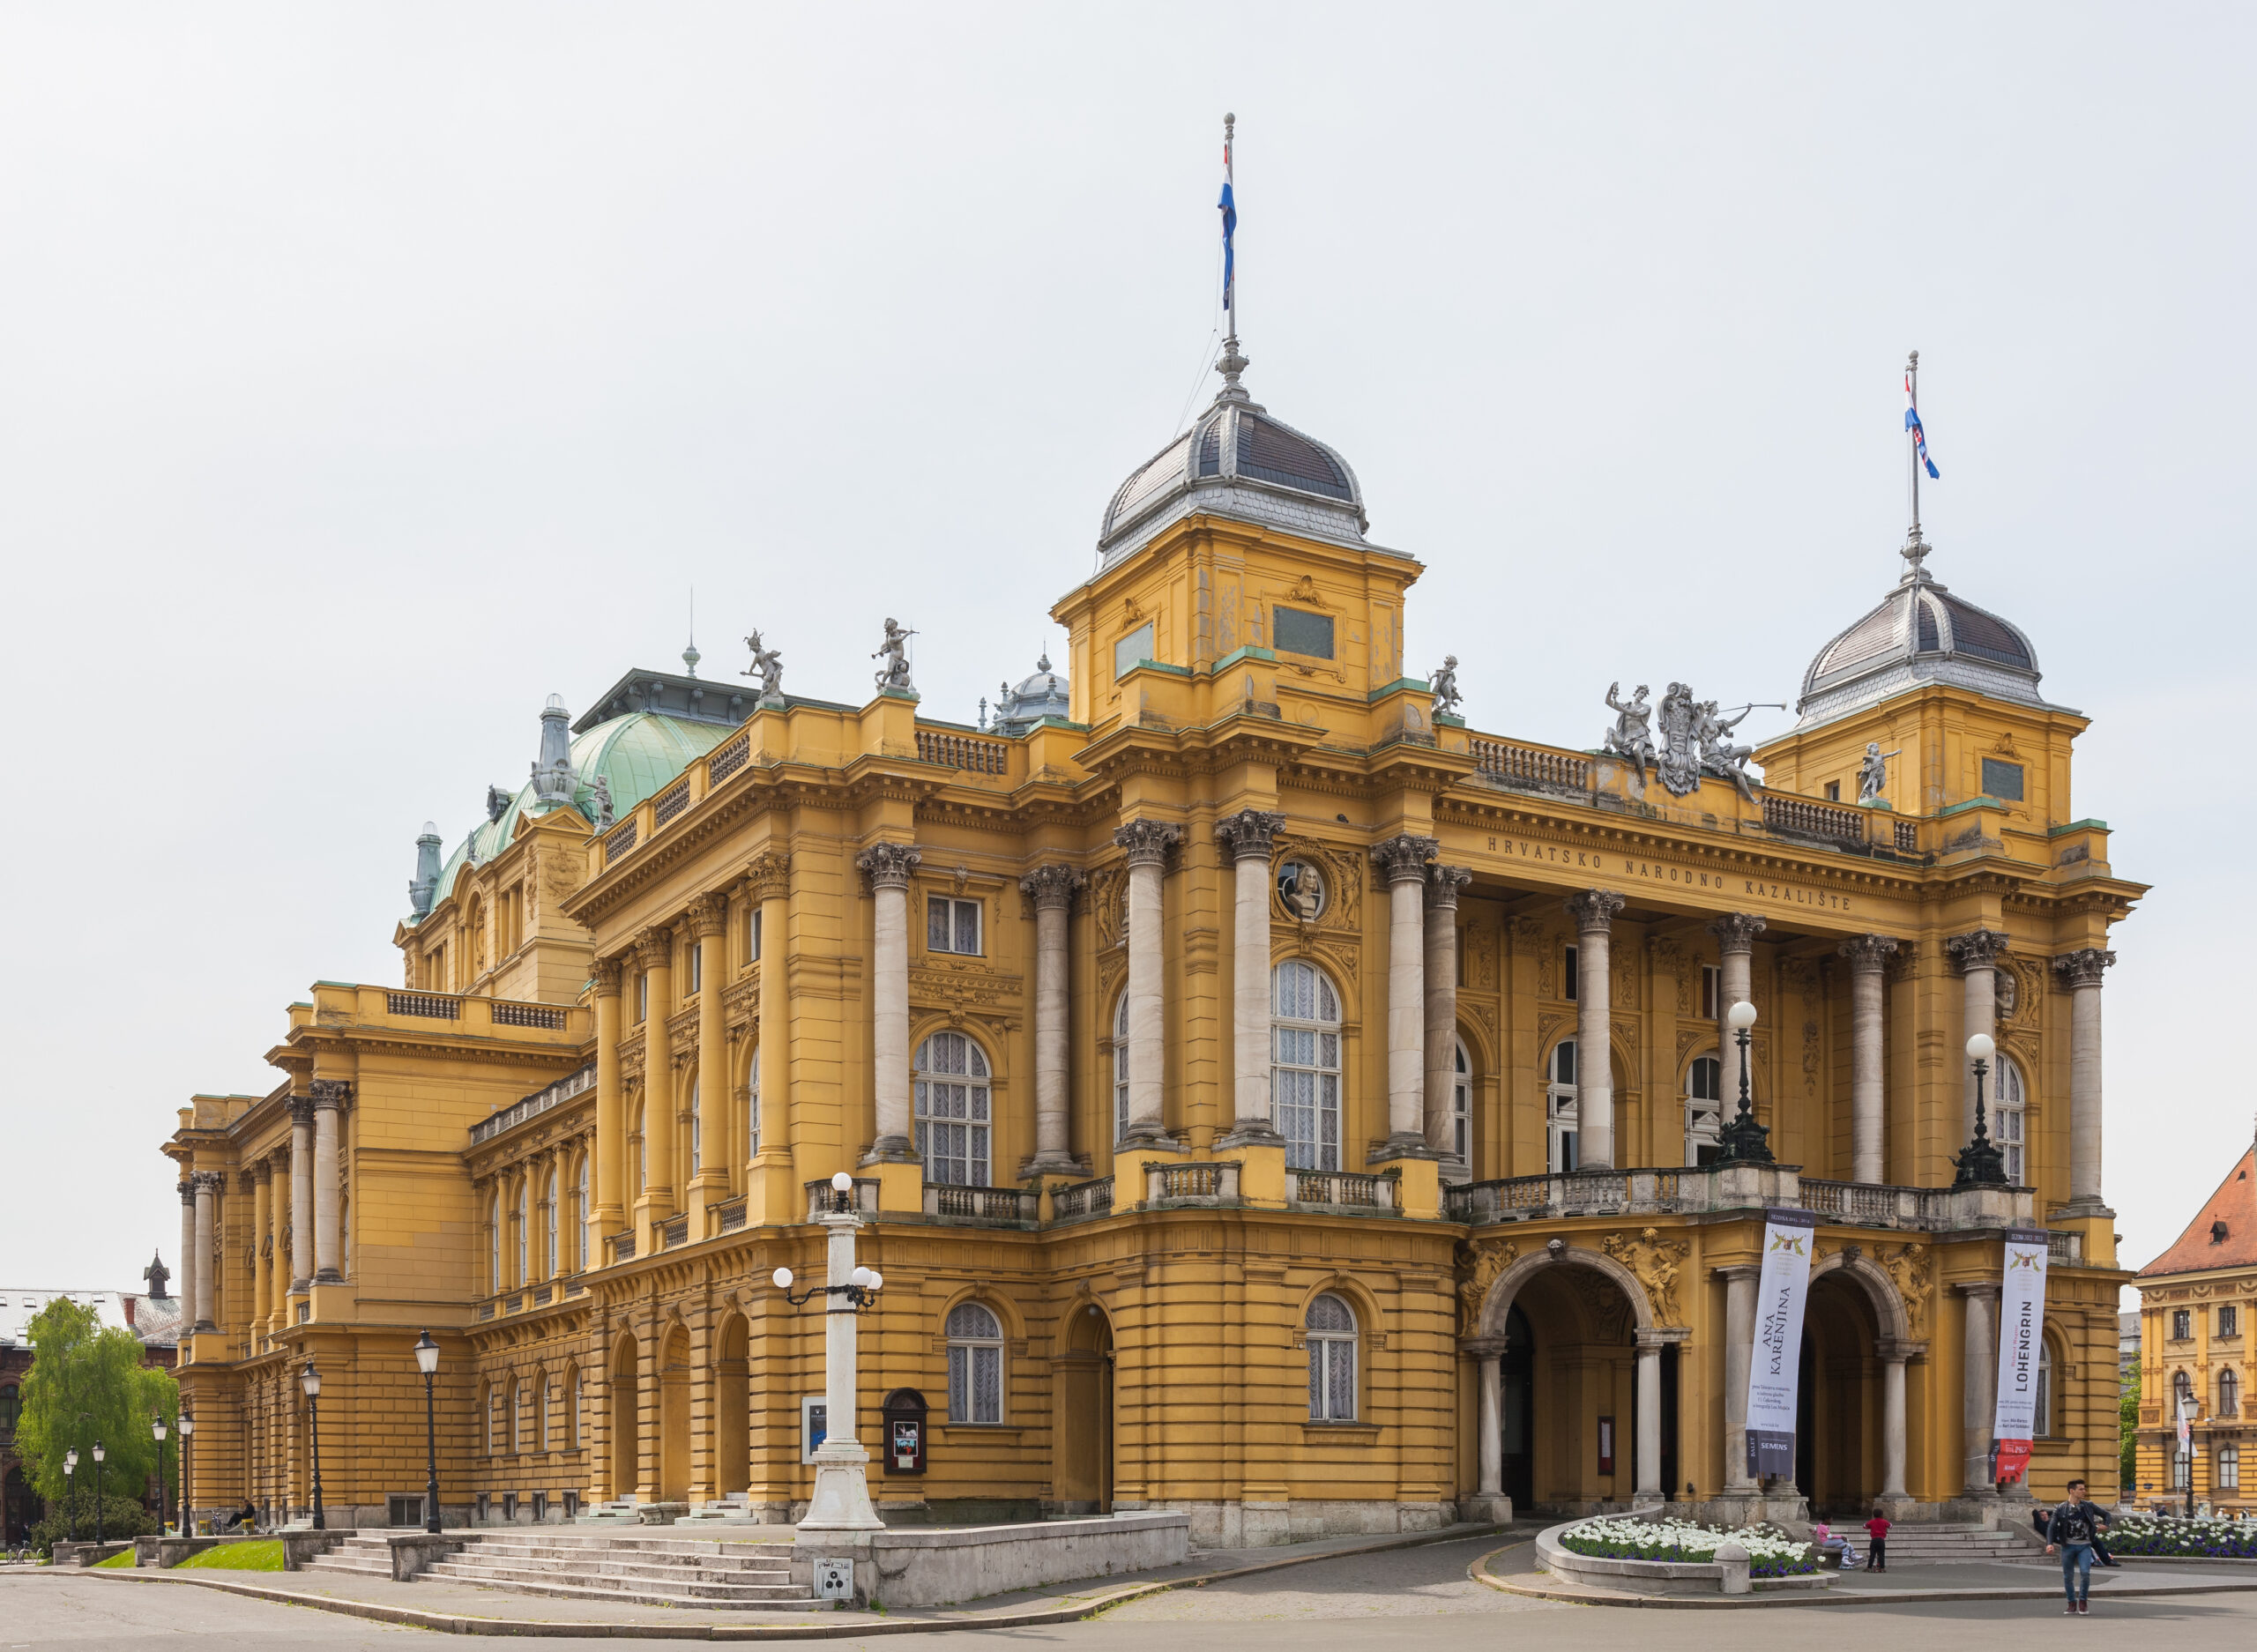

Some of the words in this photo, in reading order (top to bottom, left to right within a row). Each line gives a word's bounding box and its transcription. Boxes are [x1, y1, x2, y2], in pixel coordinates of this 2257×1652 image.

[1487, 837, 1602, 869] HRVATSKO
[1626, 860, 1724, 889] NARODNO
[1746, 880, 1851, 911] KAZALIŠTE
[1762, 1313, 1775, 1347] ANA
[1770, 1287, 1791, 1375] KARENJINA
[2015, 1301, 2032, 1391] LOHENGRIN
[1761, 1442, 1788, 1451] SIEMENS
